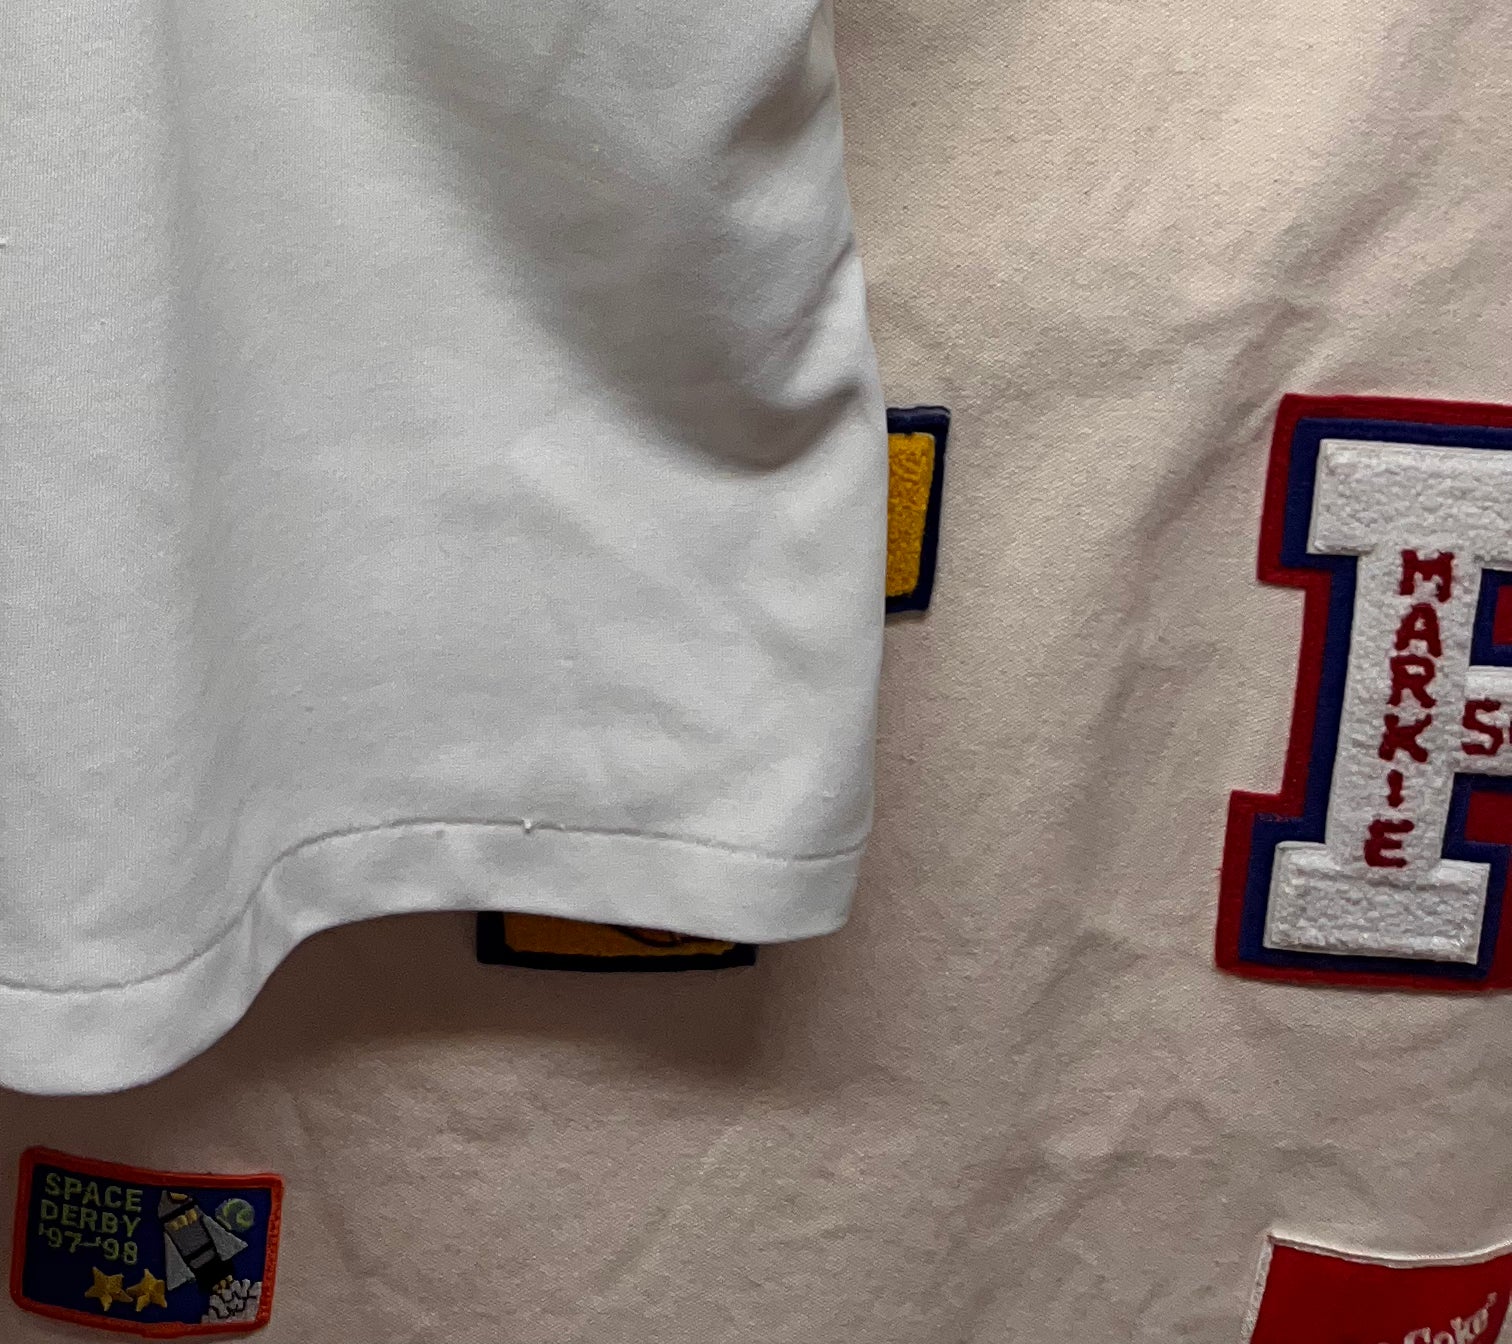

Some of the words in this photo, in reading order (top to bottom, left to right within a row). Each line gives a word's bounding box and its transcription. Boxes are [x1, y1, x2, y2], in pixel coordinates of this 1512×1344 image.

[1363, 549, 1456, 869] MARKIE
[44, 1172, 144, 1212] SPACE
[40, 1198, 141, 1237] DERBY
